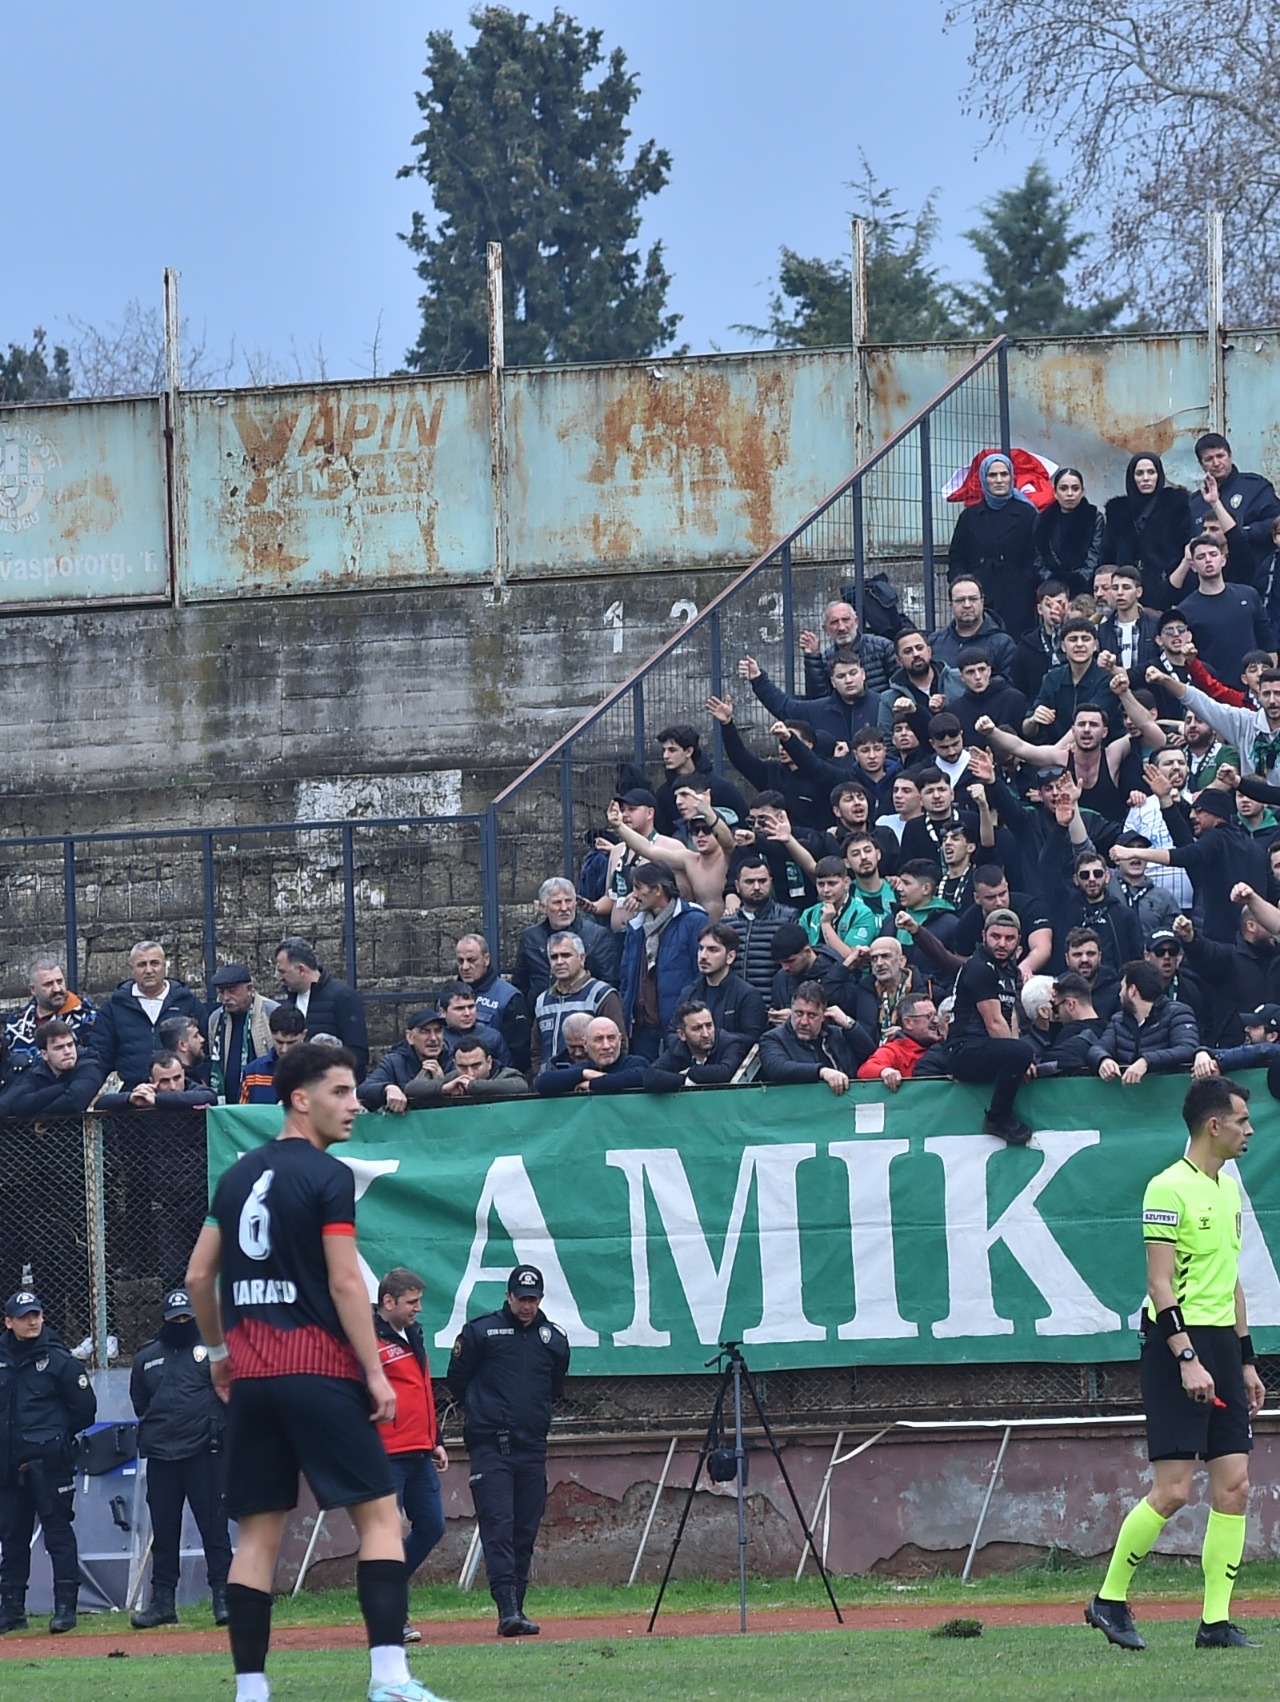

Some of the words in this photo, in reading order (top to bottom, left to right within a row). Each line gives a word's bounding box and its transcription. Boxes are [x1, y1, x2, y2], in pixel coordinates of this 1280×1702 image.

[232, 397, 447, 482] YAPIN
[475, 996, 499, 1009] POLIS
[238, 1169, 276, 1261] 6
[1144, 1213, 1175, 1223] SZUTEST
